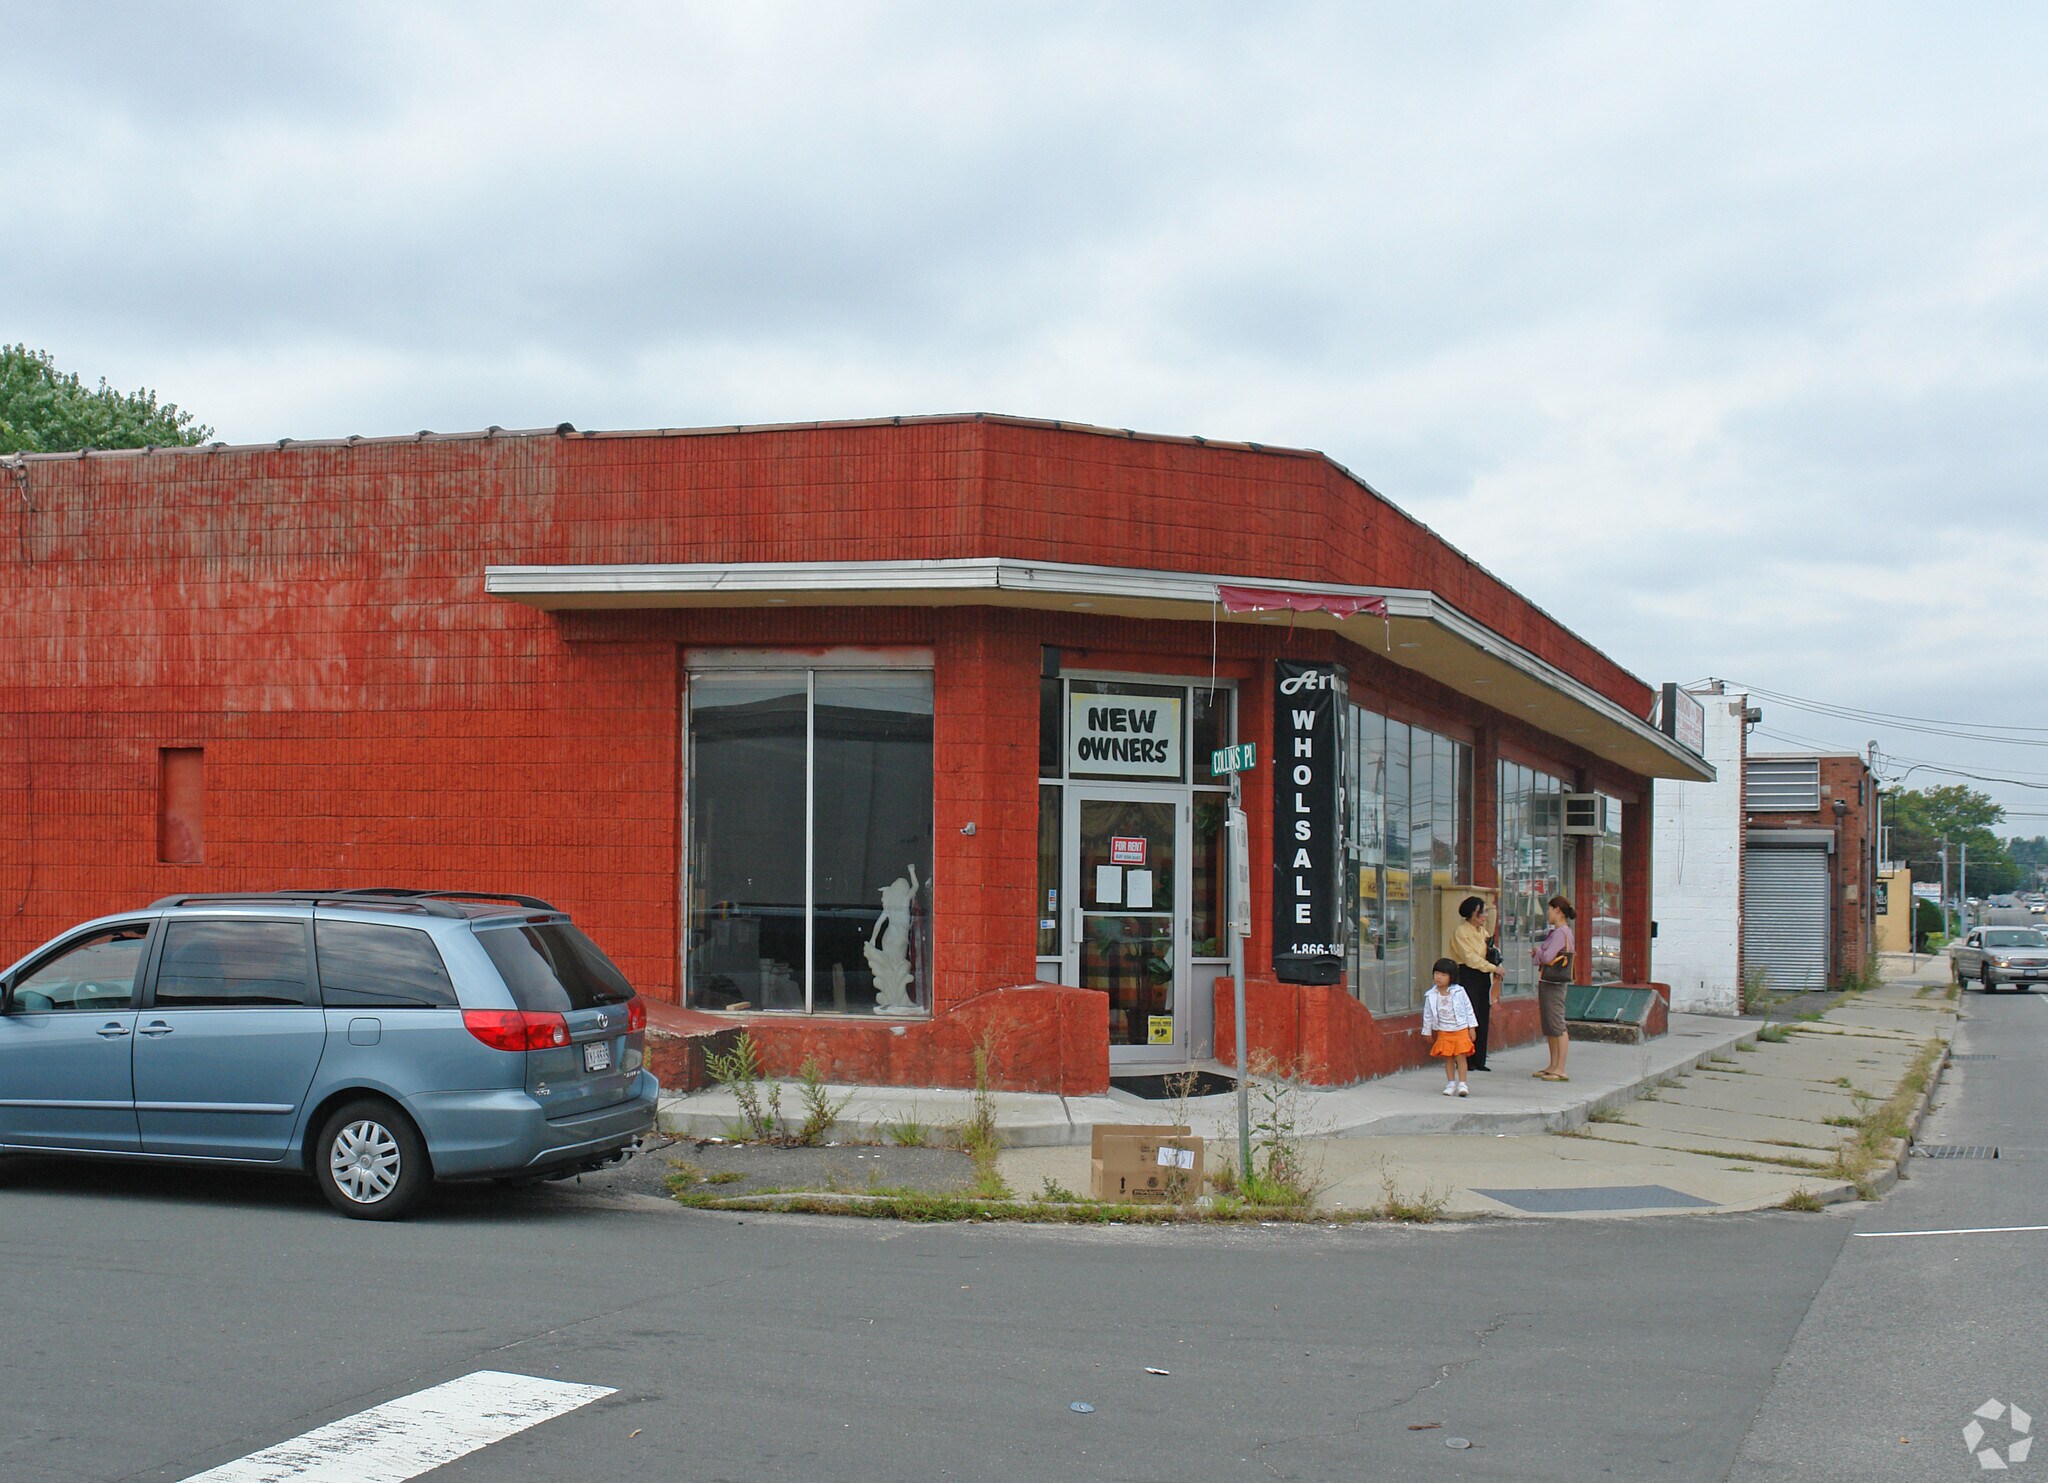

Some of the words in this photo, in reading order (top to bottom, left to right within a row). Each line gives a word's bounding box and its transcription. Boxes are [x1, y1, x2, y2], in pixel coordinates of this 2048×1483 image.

[1088, 707, 1157, 733] NEW
[1078, 737, 1169, 763] OWNERS
[1214, 746, 1241, 774] COLLINS
[1244, 744, 1255, 768] PL
[1291, 709, 1316, 923] WHOLSALE
[1114, 840, 1127, 851] FOR
[1127, 841, 1143, 852] RENT
